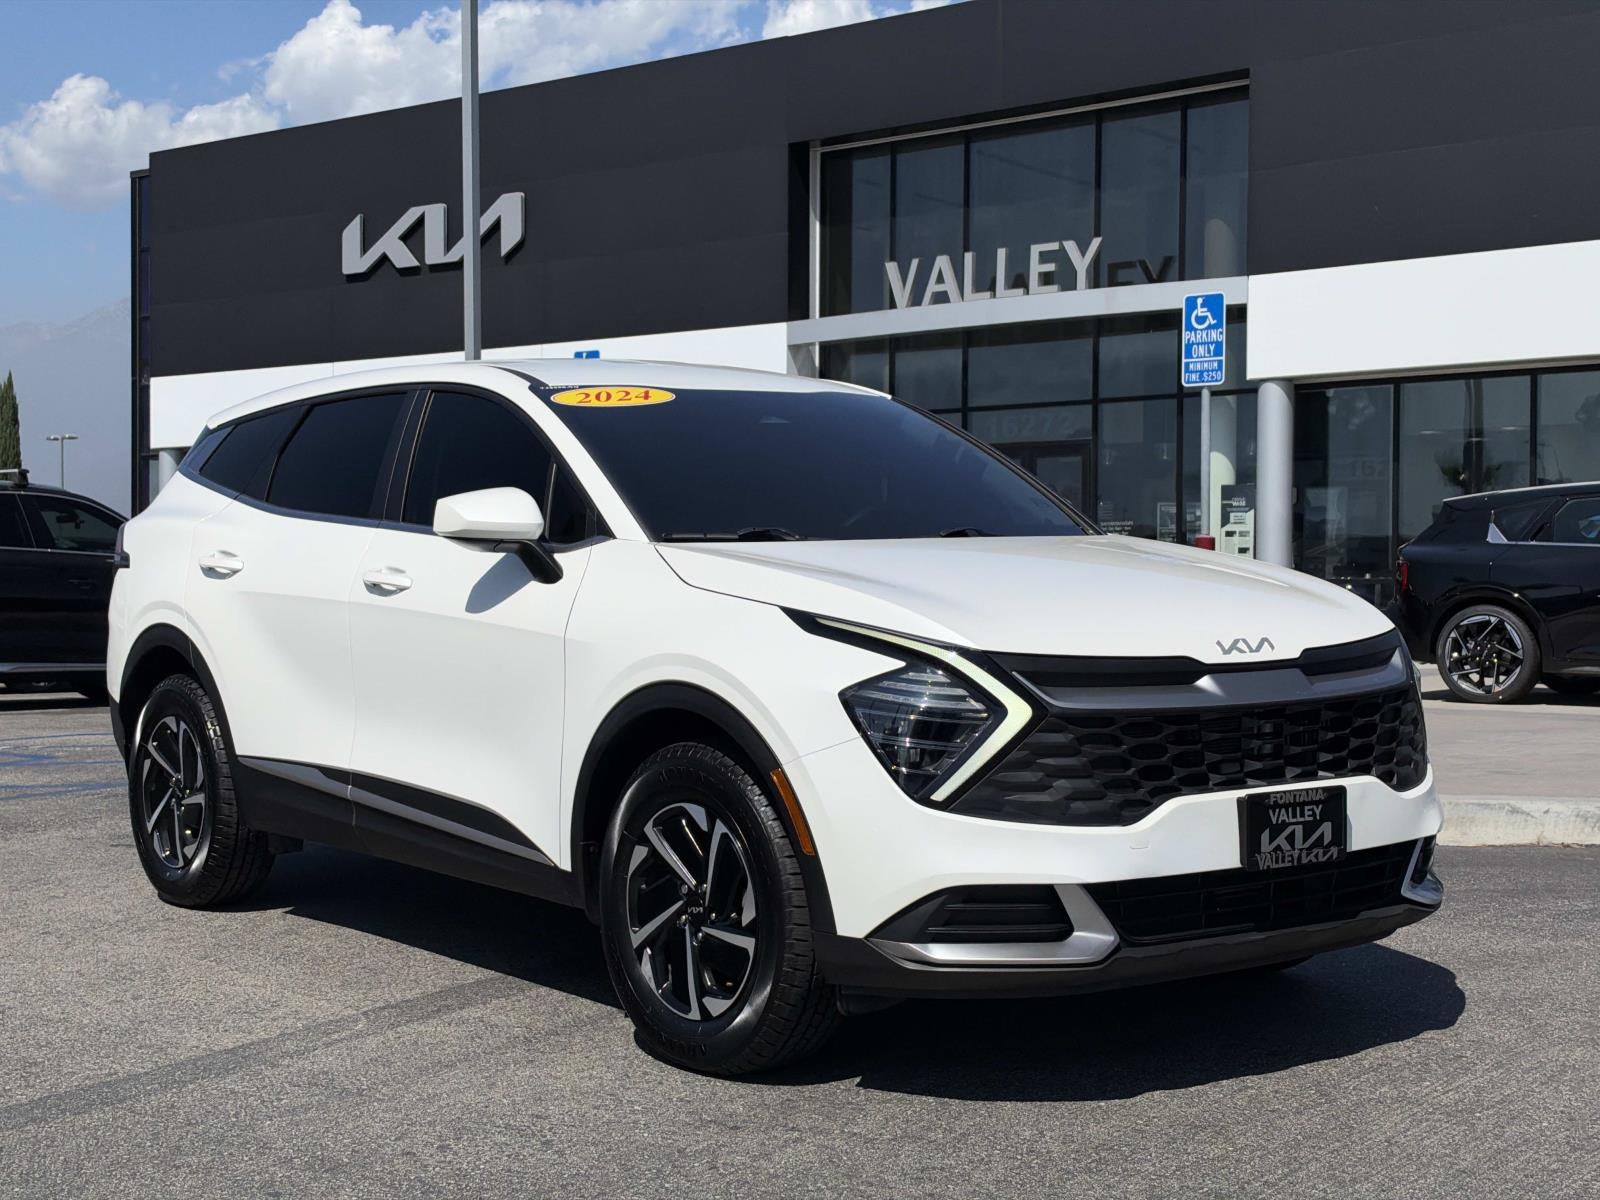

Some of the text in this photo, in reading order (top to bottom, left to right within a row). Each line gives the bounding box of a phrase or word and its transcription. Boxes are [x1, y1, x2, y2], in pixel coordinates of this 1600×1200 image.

[885, 237, 1102, 309] VALLEY
[1185, 328, 1223, 344] PARKING
[1192, 343, 1215, 358] ONLY
[1189, 361, 1218, 371] MINIMUM
[1185, 372, 1200, 382] FINE
[575, 389, 653, 404] 2024
[1216, 637, 1275, 655] KIA
[1269, 789, 1325, 805] FONTANA
[1268, 804, 1322, 824] VALLEY
[1260, 821, 1332, 852] KIA
[1256, 849, 1301, 870] VALLEY
